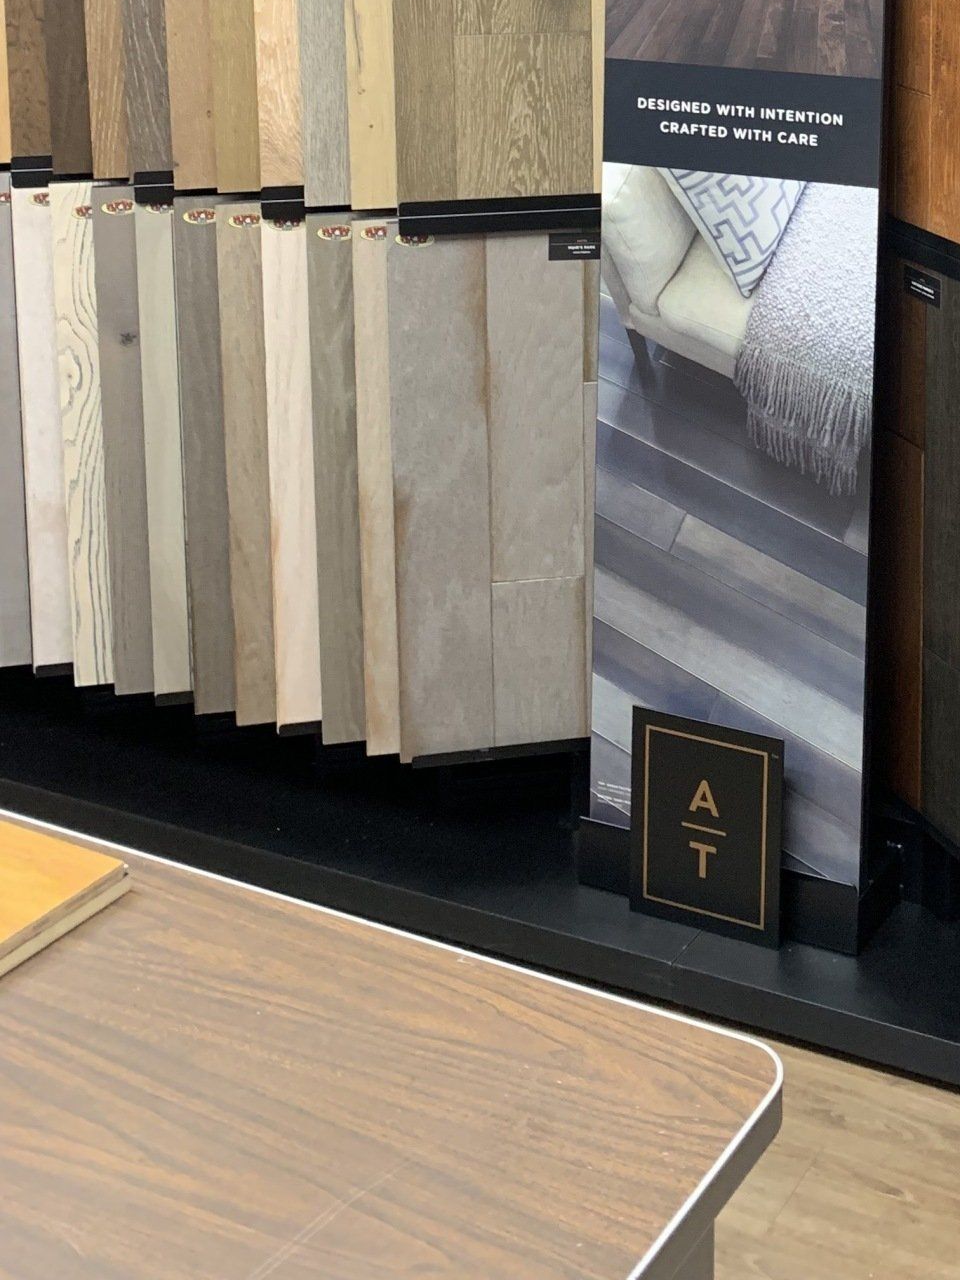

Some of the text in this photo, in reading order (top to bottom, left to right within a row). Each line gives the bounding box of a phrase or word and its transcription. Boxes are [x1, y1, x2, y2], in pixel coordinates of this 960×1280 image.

[637, 97, 843, 126] DESIGNED WITH INTENTION
[660, 121, 819, 147] CRAFTED WITH CARE
[689, 779, 719, 818] A
[689, 840, 717, 879] T
